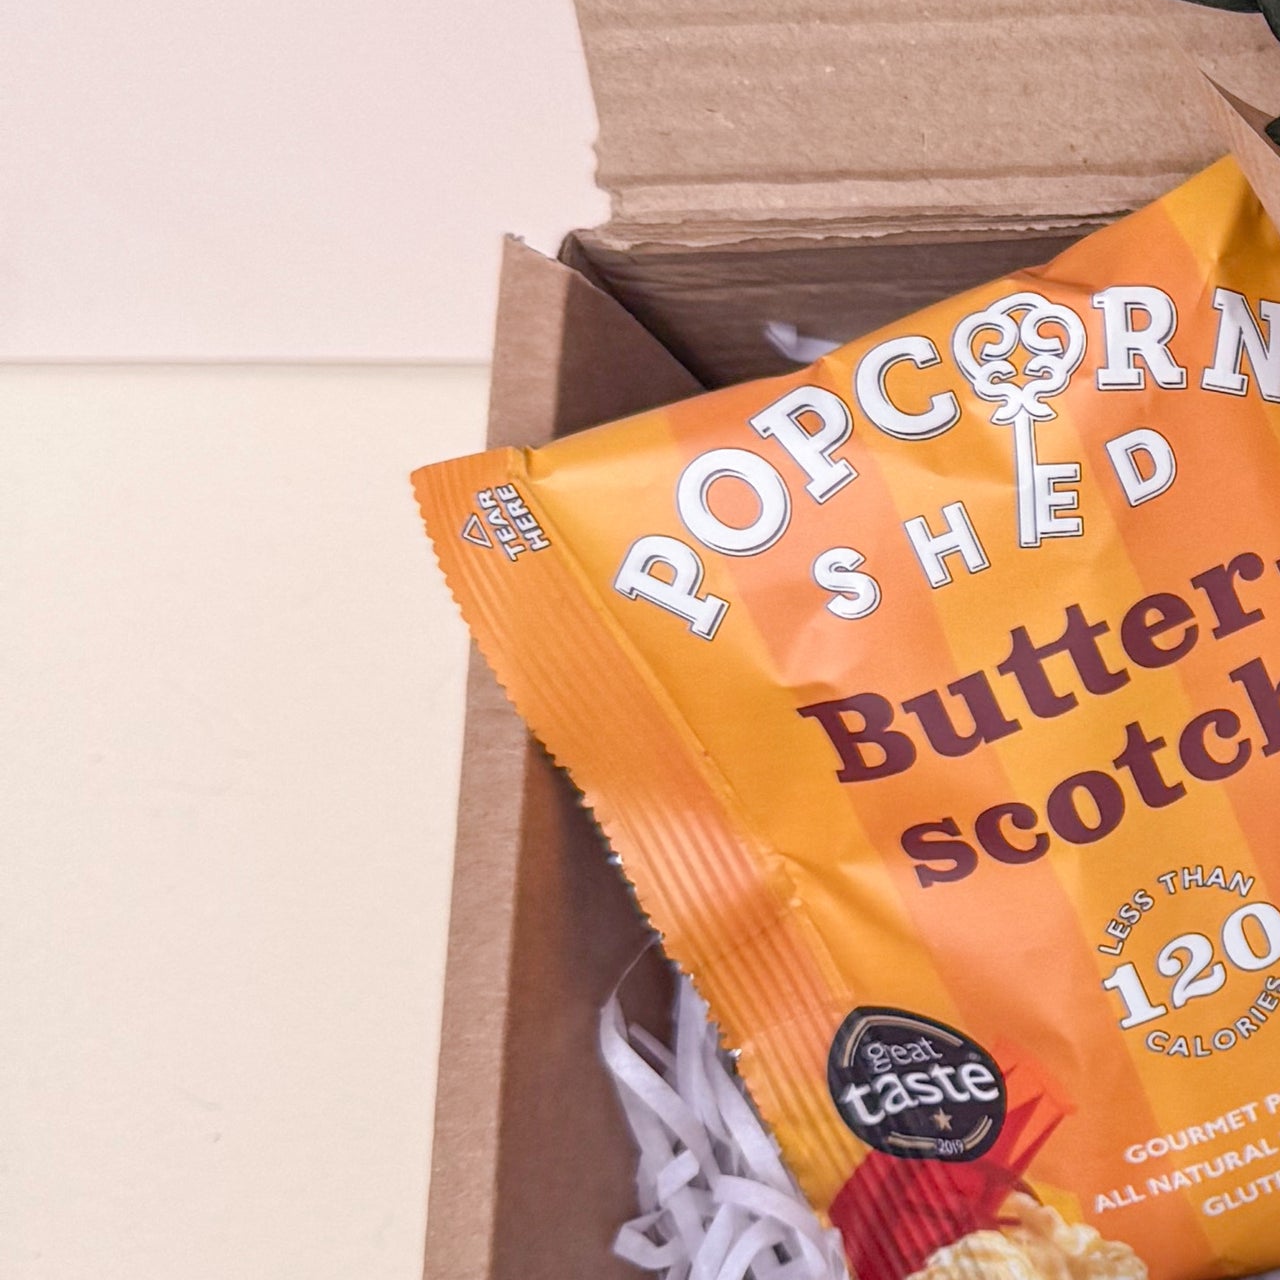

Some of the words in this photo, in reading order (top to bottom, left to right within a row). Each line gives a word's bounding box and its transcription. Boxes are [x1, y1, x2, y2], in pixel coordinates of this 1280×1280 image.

[477, 487, 527, 562] TEAR
[494, 482, 552, 552] HERE
[811, 426, 1178, 620] SHED
[1098, 888, 1155, 956] LESS
[1157, 864, 1256, 898] THAN
[866, 1036, 943, 1073] geat
[842, 1062, 1000, 1125] taste
[936, 1138, 965, 1155] 2019
[1123, 1101, 1259, 1165] GOURMET
[1094, 1184, 1146, 1214] ALL
[1146, 1137, 1280, 1197] NATURAL
